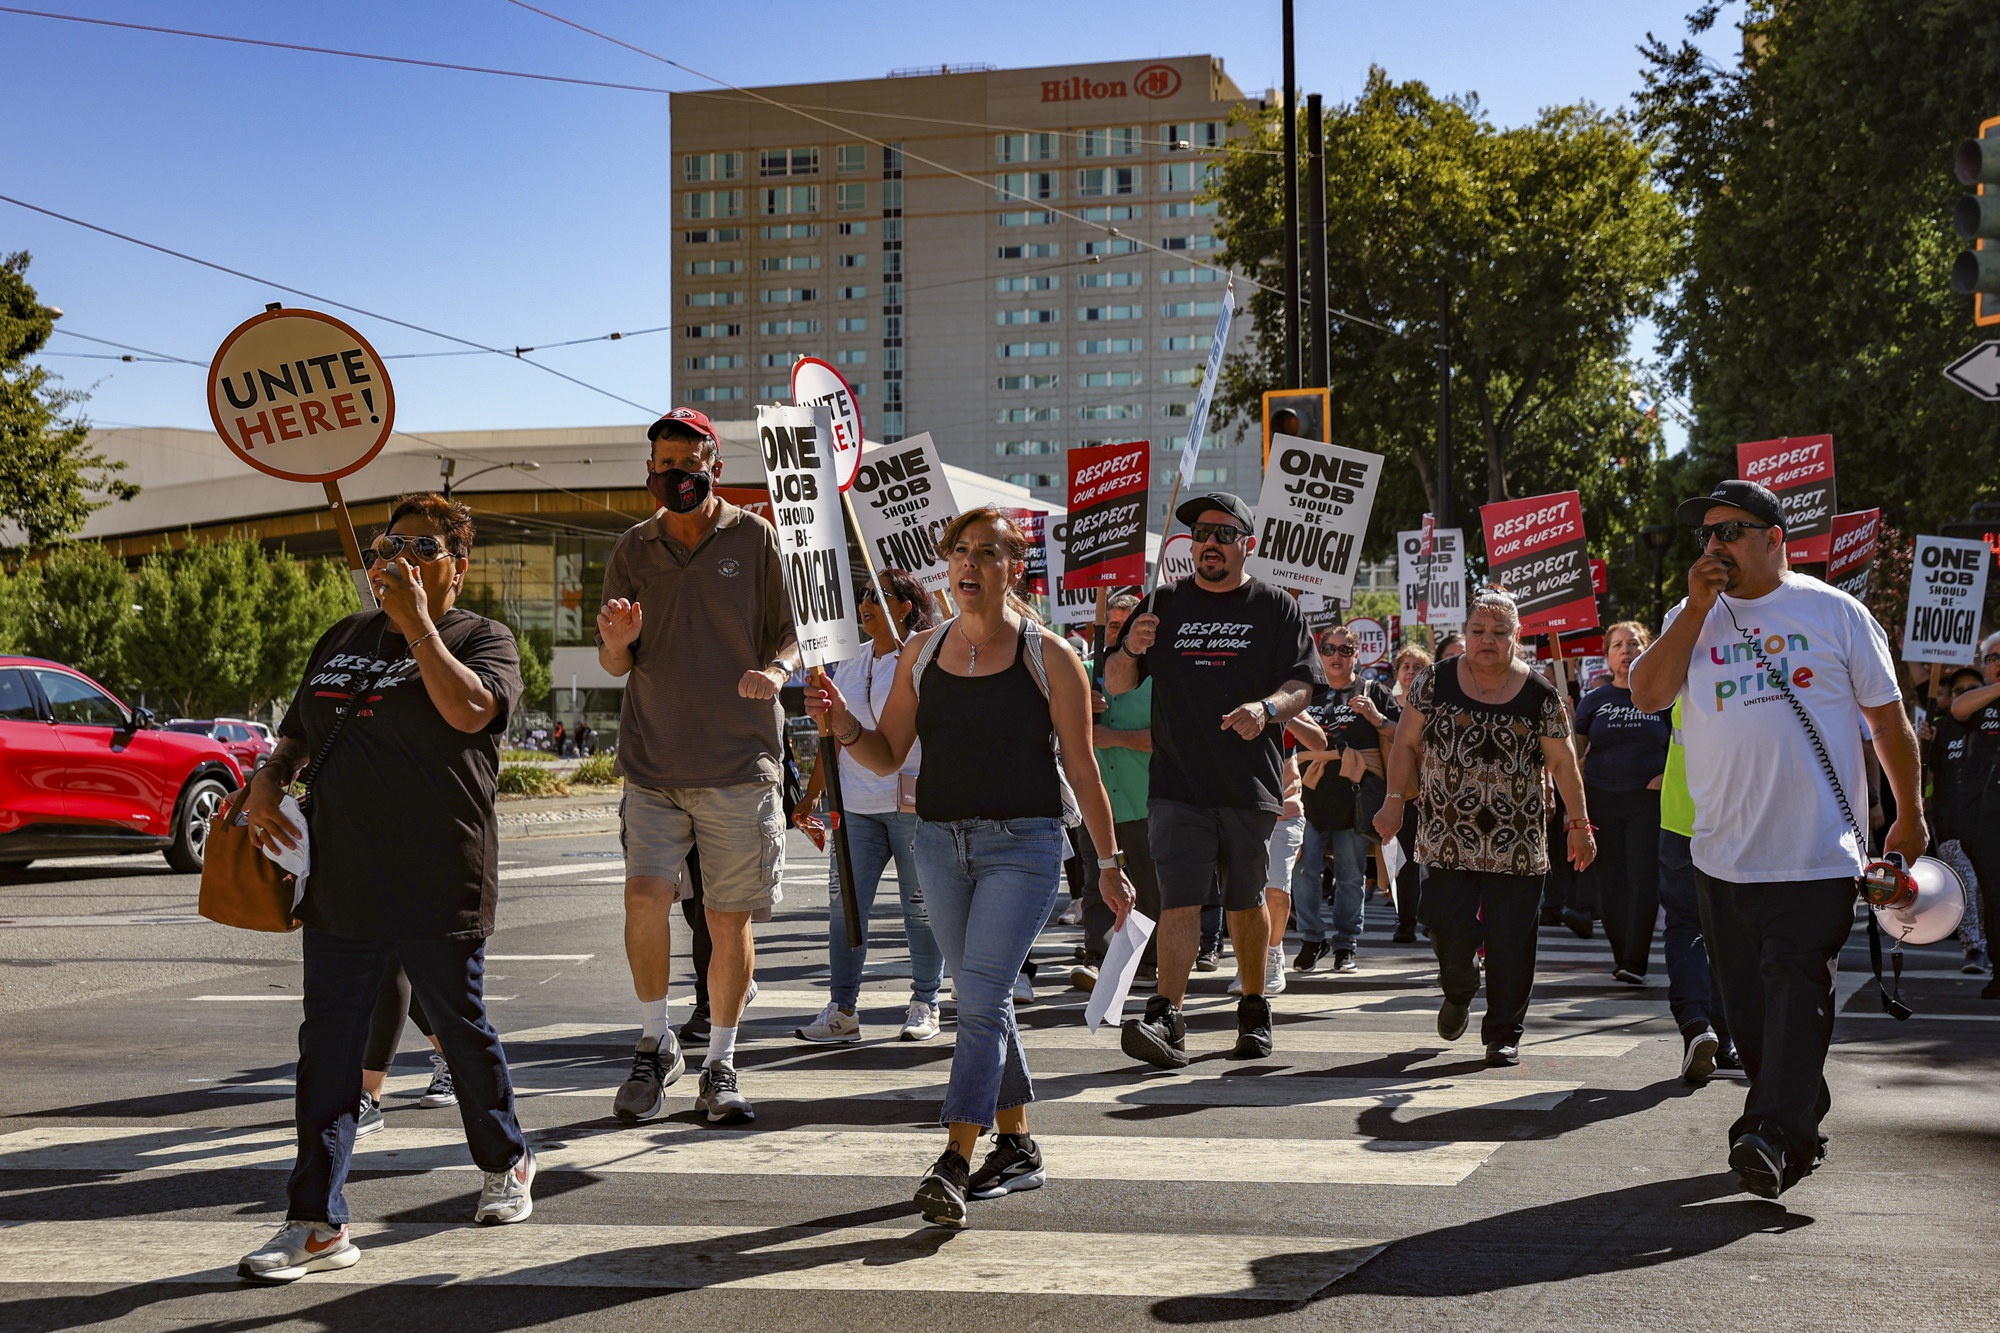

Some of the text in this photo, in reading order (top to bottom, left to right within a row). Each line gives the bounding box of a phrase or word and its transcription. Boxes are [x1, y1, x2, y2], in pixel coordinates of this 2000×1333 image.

[1041, 76, 1127, 102] Hilton
[221, 348, 372, 410] UNITE
[235, 387, 380, 450] HERE!
[761, 425, 821, 472] ONE
[1746, 443, 1823, 477] RESPECT
[852, 447, 931, 493] ONE
[1074, 451, 1142, 487] RESPECT
[1279, 448, 1368, 489] ONE
[1774, 461, 1825, 484] GUESTS
[772, 474, 818, 503] JOB
[870, 476, 932, 508] JOB
[1073, 471, 1142, 504] OUR GUESTS
[1284, 478, 1355, 505] JOB
[1781, 489, 1826, 510] PECT
[778, 506, 815, 526] SHOULD
[882, 497, 929, 520] SHOULD
[902, 513, 918, 527] BE
[1072, 503, 1140, 536] RESPECT
[1289, 496, 1343, 516] SHOULD
[1304, 512, 1323, 526] BE
[1493, 501, 1570, 540] RESPECT
[795, 529, 808, 547] BE
[1071, 521, 1140, 554] OUR WORK
[1257, 517, 1355, 575] ENOUGH
[1494, 520, 1575, 557] OUR GUESTS
[1832, 518, 1877, 554] RESPECT
[1165, 557, 1195, 573] UNI
[1415, 564, 1449, 575] SULD
[1500, 550, 1578, 586] RESPECT
[1830, 540, 1875, 572] OUR GUESTS
[1921, 546, 1981, 571] ONE
[1272, 567, 1323, 586] UNITEHERE!
[1514, 585, 1531, 600] UR
[1536, 568, 1582, 593] WORK
[1925, 570, 1974, 586] JOB
[1929, 585, 1967, 597] SHOULD
[1941, 597, 1953, 607] BE
[1177, 622, 1253, 636] RESPECT
[1313, 611, 1337, 622] WORK
[1912, 606, 1975, 645] ENOUGH
[1174, 638, 1251, 649] OUR WORK
[1710, 628, 1809, 665] union
[310, 673, 351, 687] OUR
[1715, 657, 1814, 712] pride
[1624, 712, 1660, 722] Hilton
